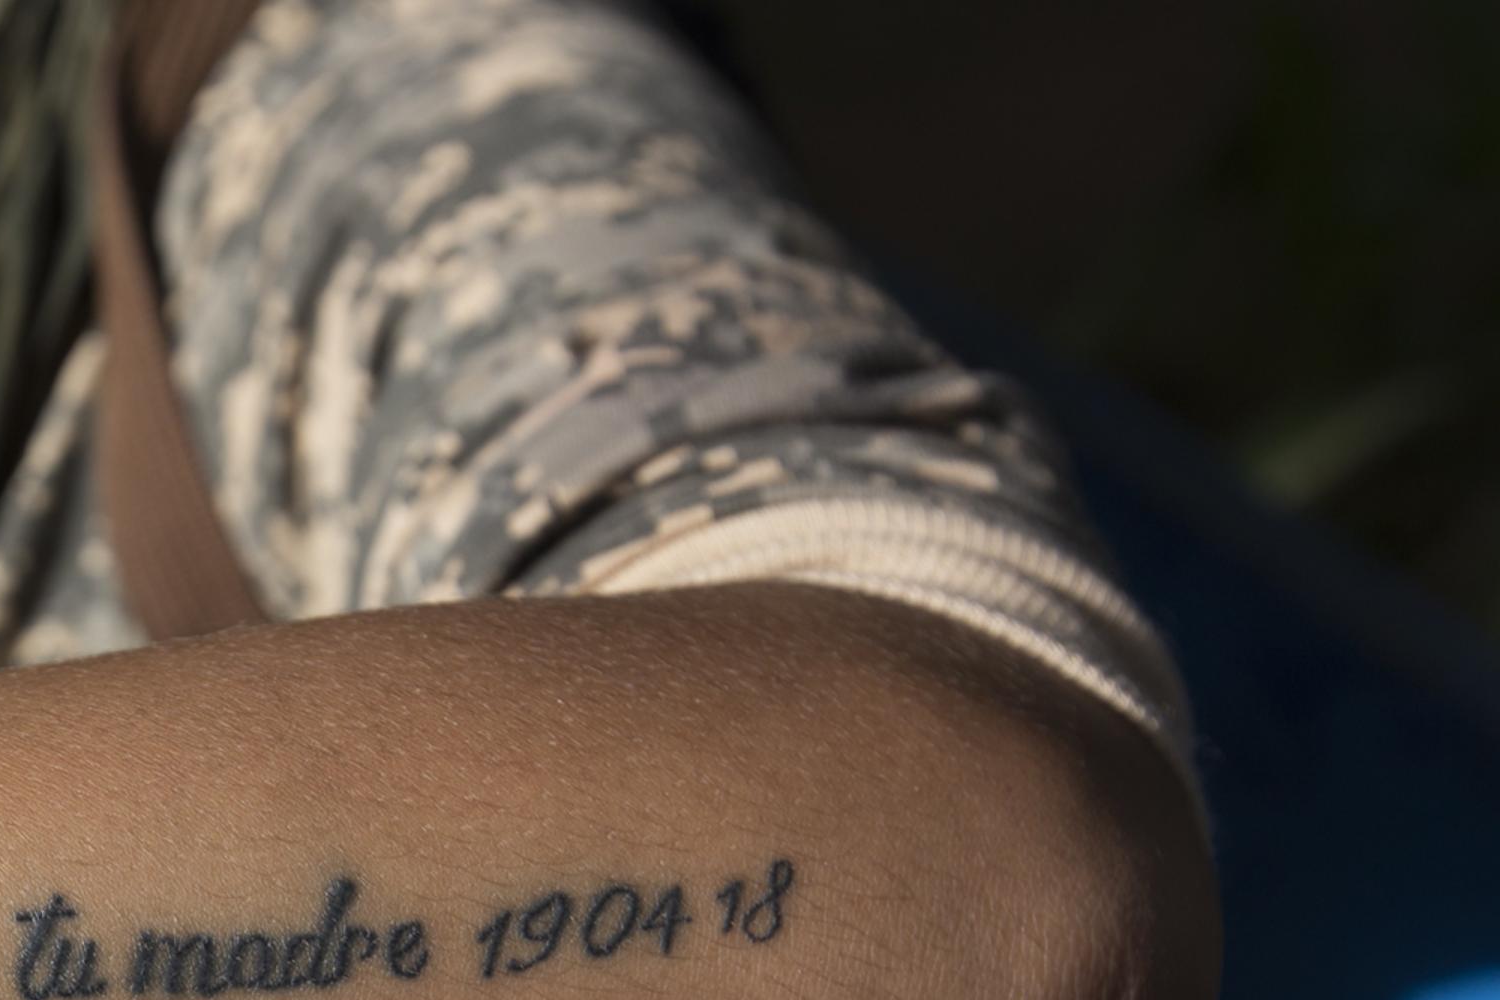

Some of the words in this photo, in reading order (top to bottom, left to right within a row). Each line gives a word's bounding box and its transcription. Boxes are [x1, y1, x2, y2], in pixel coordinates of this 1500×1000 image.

[128, 876, 431, 1000] madre
[476, 886, 692, 979] 1904
[716, 859, 796, 944] 18
